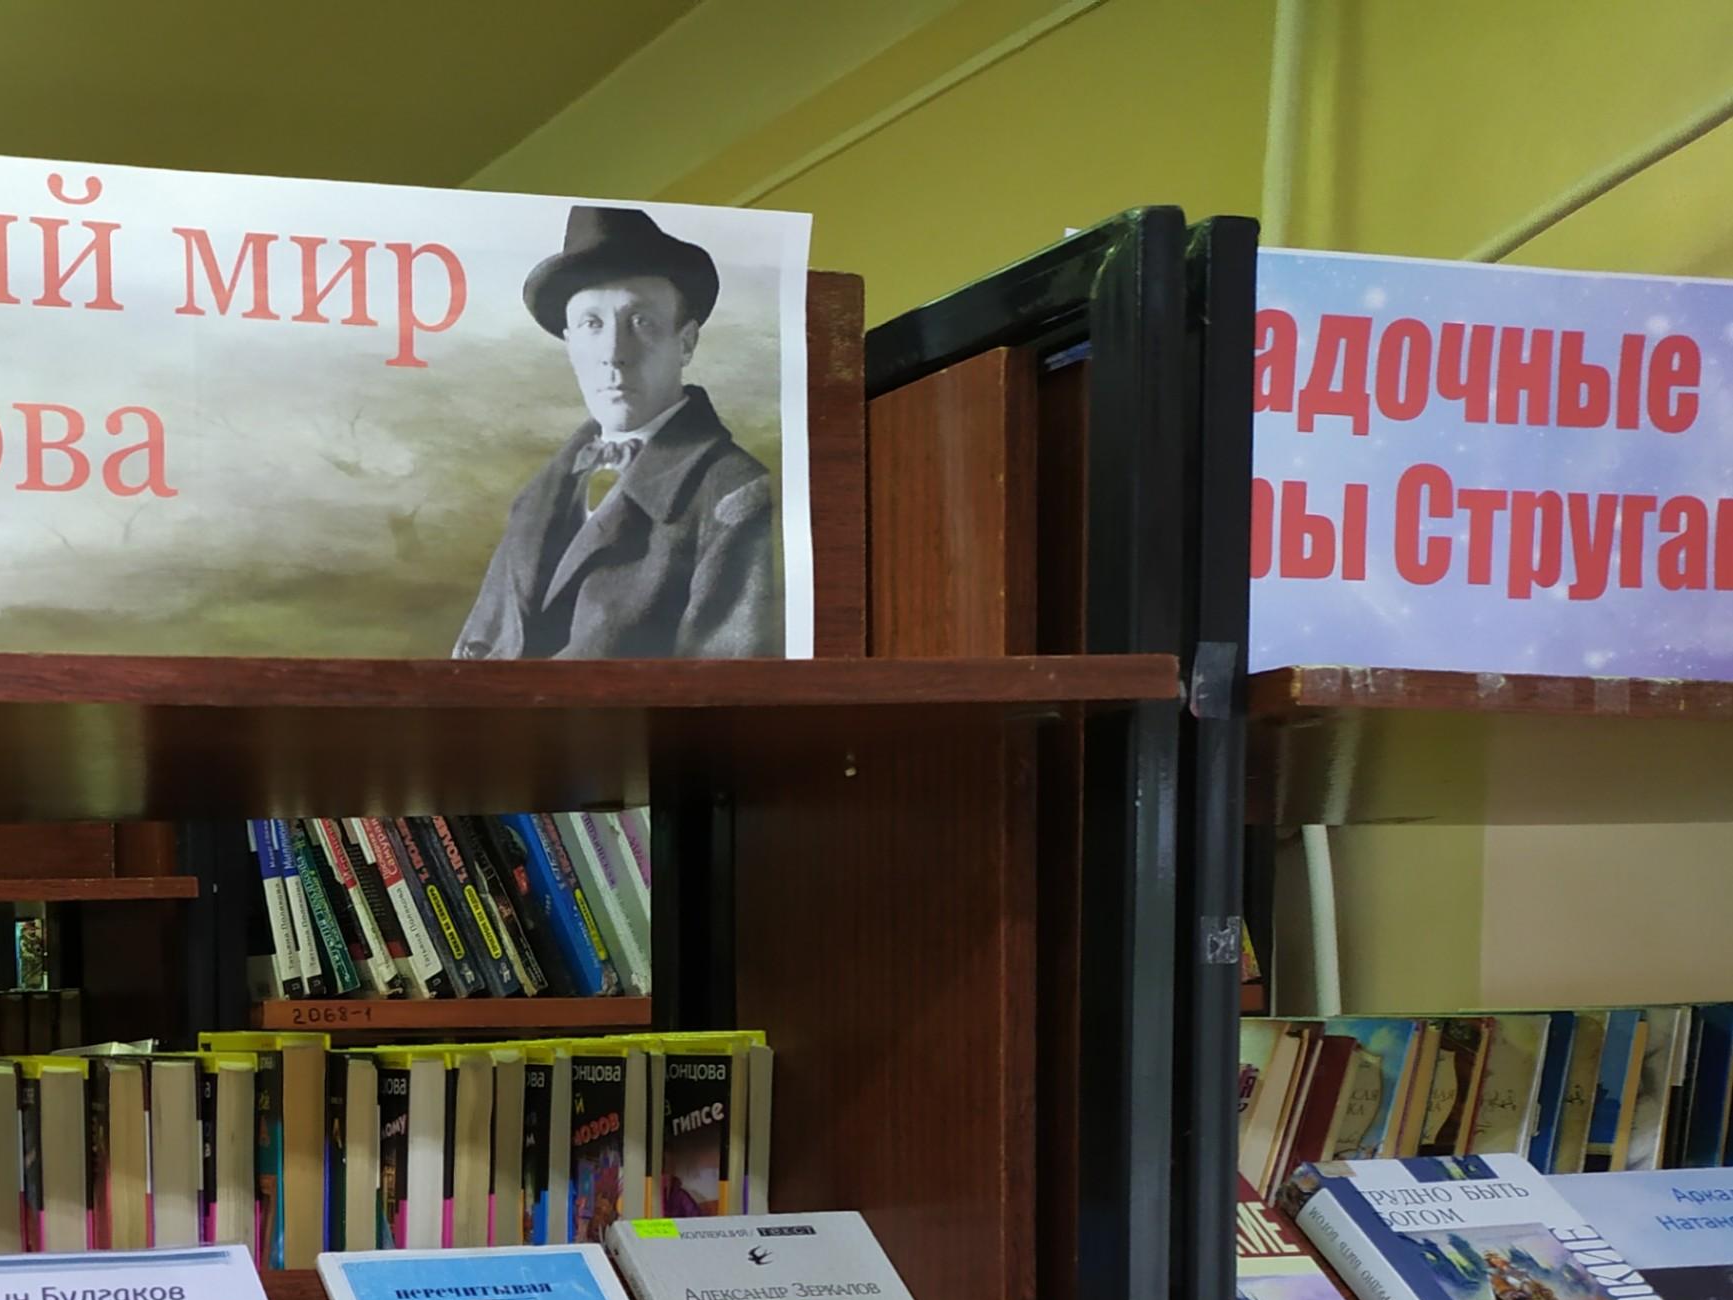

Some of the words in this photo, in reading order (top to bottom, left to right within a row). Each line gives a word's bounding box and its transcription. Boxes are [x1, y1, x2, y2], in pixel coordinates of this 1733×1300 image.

[172, 226, 468, 368] мир
[667, 1063, 726, 1081] онцова
[672, 1102, 726, 1137] гипсе
[1463, 1182, 1530, 1200] БЫТЬ
[1671, 1186, 1733, 1206] Арка
